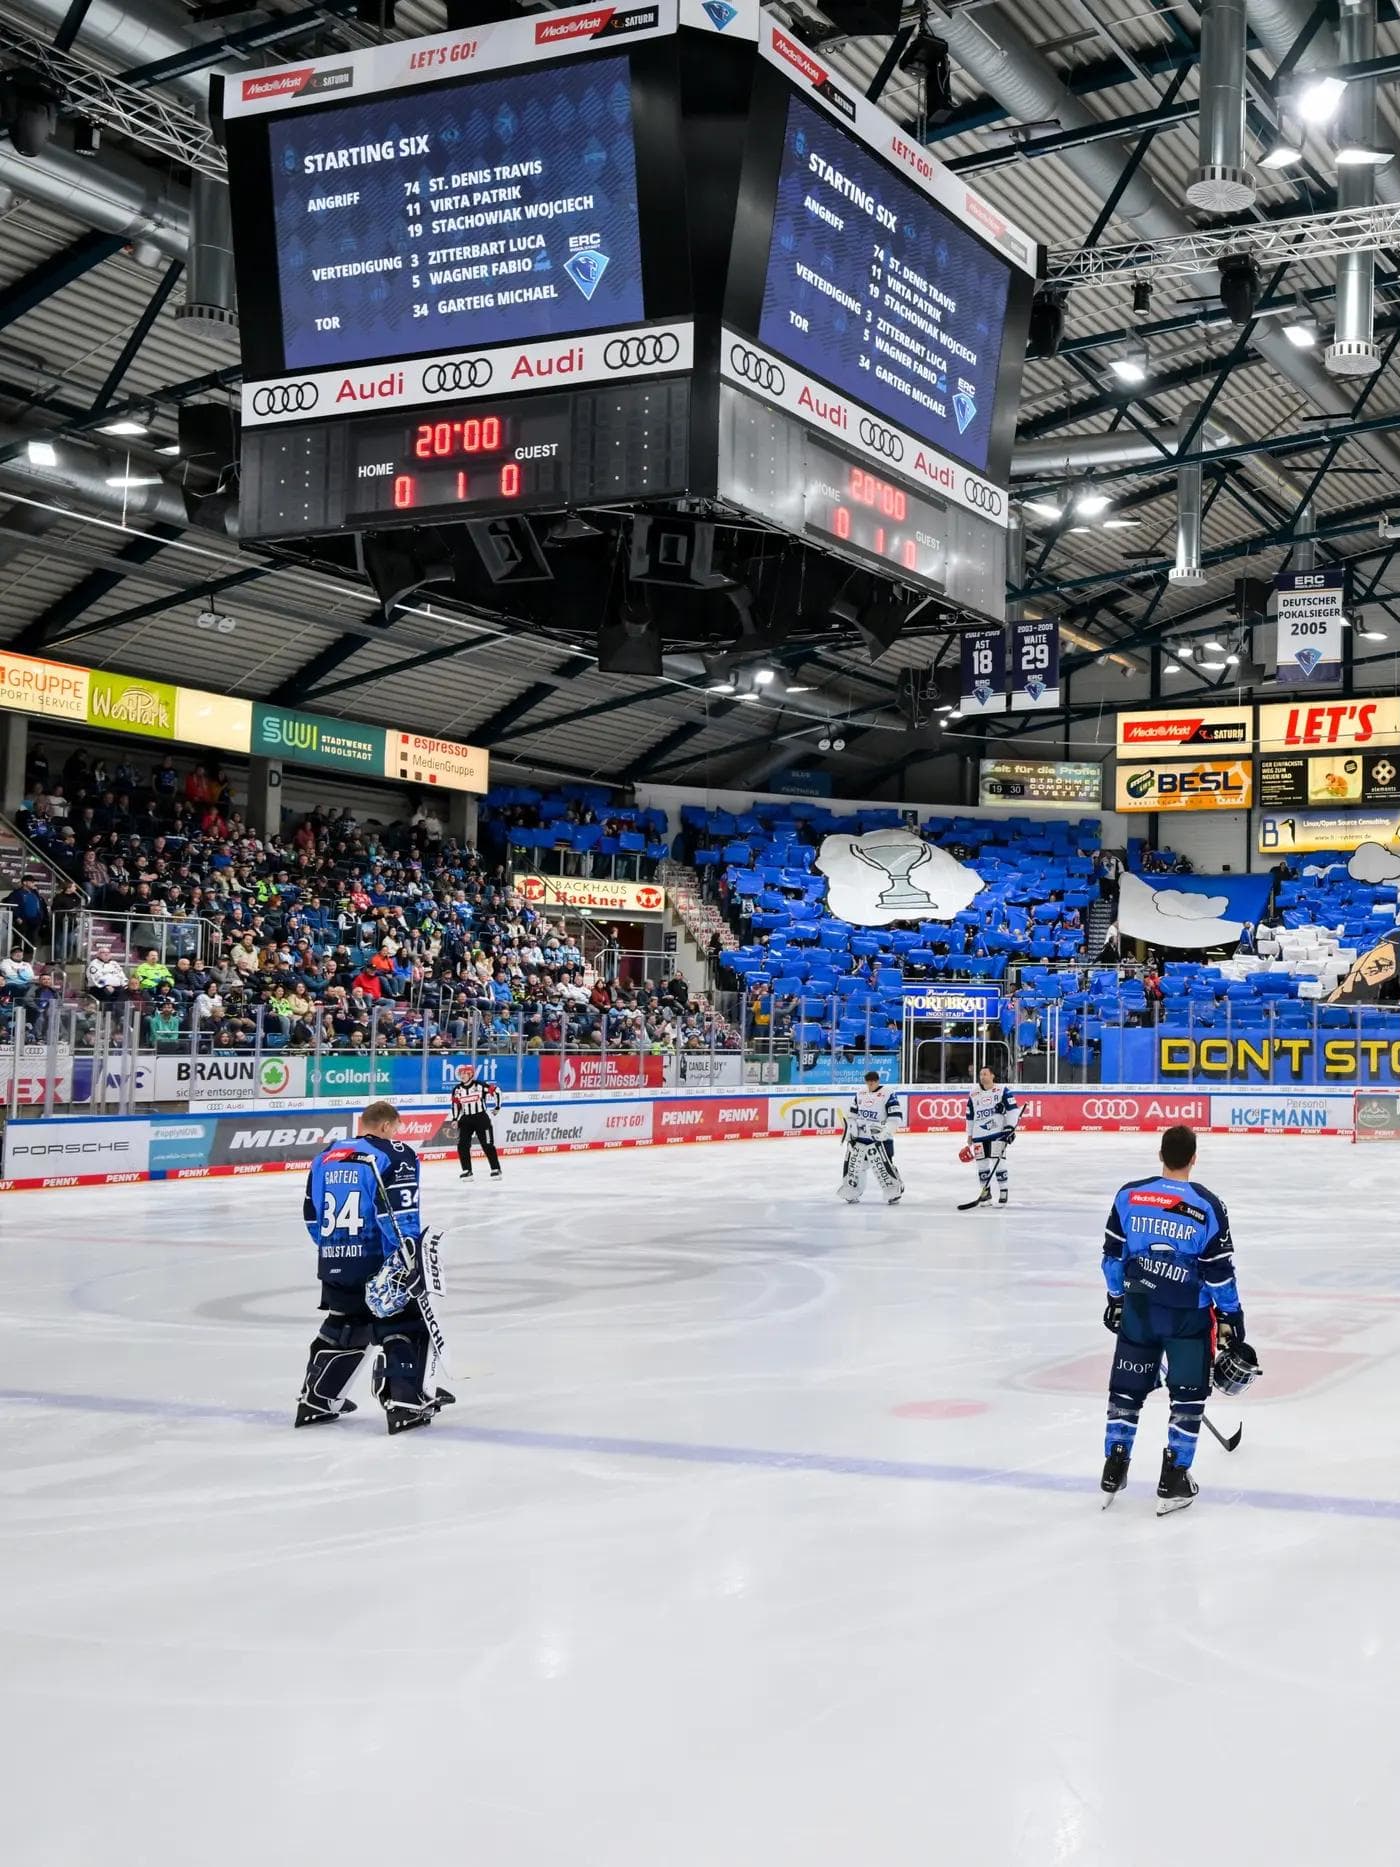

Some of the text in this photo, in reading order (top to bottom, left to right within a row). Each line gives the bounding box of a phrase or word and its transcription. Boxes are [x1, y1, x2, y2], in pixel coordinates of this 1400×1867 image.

[625, 11, 654, 28] SATURN
[409, 42, 477, 70] LET'S GO!
[323, 72, 350, 88] SATURN
[304, 134, 430, 174] STARTING SIX
[404, 160, 543, 197] 74 ST. DENIS TRAVIS
[307, 191, 360, 212] ANGRIFF
[406, 185, 521, 217] 11 VIRTA PATRIK
[407, 195, 594, 238] 19 STACHOWIAK WOJCIECH
[568, 233, 601, 249] ERC
[312, 256, 402, 282] VERTEIDIGUNG
[411, 254, 419, 267] 3
[428, 241, 506, 265] ZITTERBART
[509, 234, 546, 254] LUCA
[412, 257, 532, 288] 5 WAGNER FABIO
[412, 285, 558, 318] 34 GARTEIG MICHAEL
[315, 316, 340, 332] TOR
[335, 348, 584, 403] Audi Audi
[798, 385, 955, 491] Audi Audi
[515, 443, 558, 460] GUEST
[358, 463, 394, 478] HOME
[916, 531, 941, 551] GUEST
[1294, 575, 1325, 585] ERC
[1283, 596, 1337, 607] DEUTSCHER
[1279, 608, 1340, 619] POKALSIEGER
[1291, 621, 1327, 636] 2005
[975, 640, 990, 649] AST
[1024, 635, 1047, 643] WAITE
[972, 650, 992, 675] 18
[1022, 644, 1049, 670] 29
[8, 668, 83, 699] GRUPPE
[38, 694, 82, 712] SERVICE
[262, 716, 318, 751] SWI
[1284, 704, 1377, 745] LET'S
[321, 735, 372, 751] STADTWERKE
[1214, 728, 1244, 740] SATURN
[321, 745, 372, 761] INGOLSTADT
[414, 735, 468, 758] espresso
[412, 754, 475, 777] MedienGruppe
[1015, 766, 1034, 774] für
[1036, 766, 1055, 775] die
[269, 770, 281, 788] D
[1158, 771, 1243, 792] BESL
[992, 784, 1022, 794] 19 30
[556, 881, 627, 895] BACKHAUS
[555, 891, 627, 907] Hackner
[1160, 1039, 1309, 1073] DON'T
[177, 1062, 254, 1082] BRAUN
[1145, 1101, 1203, 1120] Audi
[1286, 1099, 1327, 1108] Personal
[512, 1111, 558, 1125] Die beste
[606, 1114, 644, 1129] LET'S GO!
[792, 1107, 835, 1128] DIGI
[1231, 1108, 1327, 1127] HOFMANN
[229, 1126, 348, 1150] MBDA
[505, 1126, 583, 1143] Technik? Check!
[12, 1141, 130, 1156] PORSCHE
[325, 1169, 359, 1185] GARTEIG
[321, 1191, 364, 1238] 34
[1117, 1358, 1154, 1375] JOOP!
